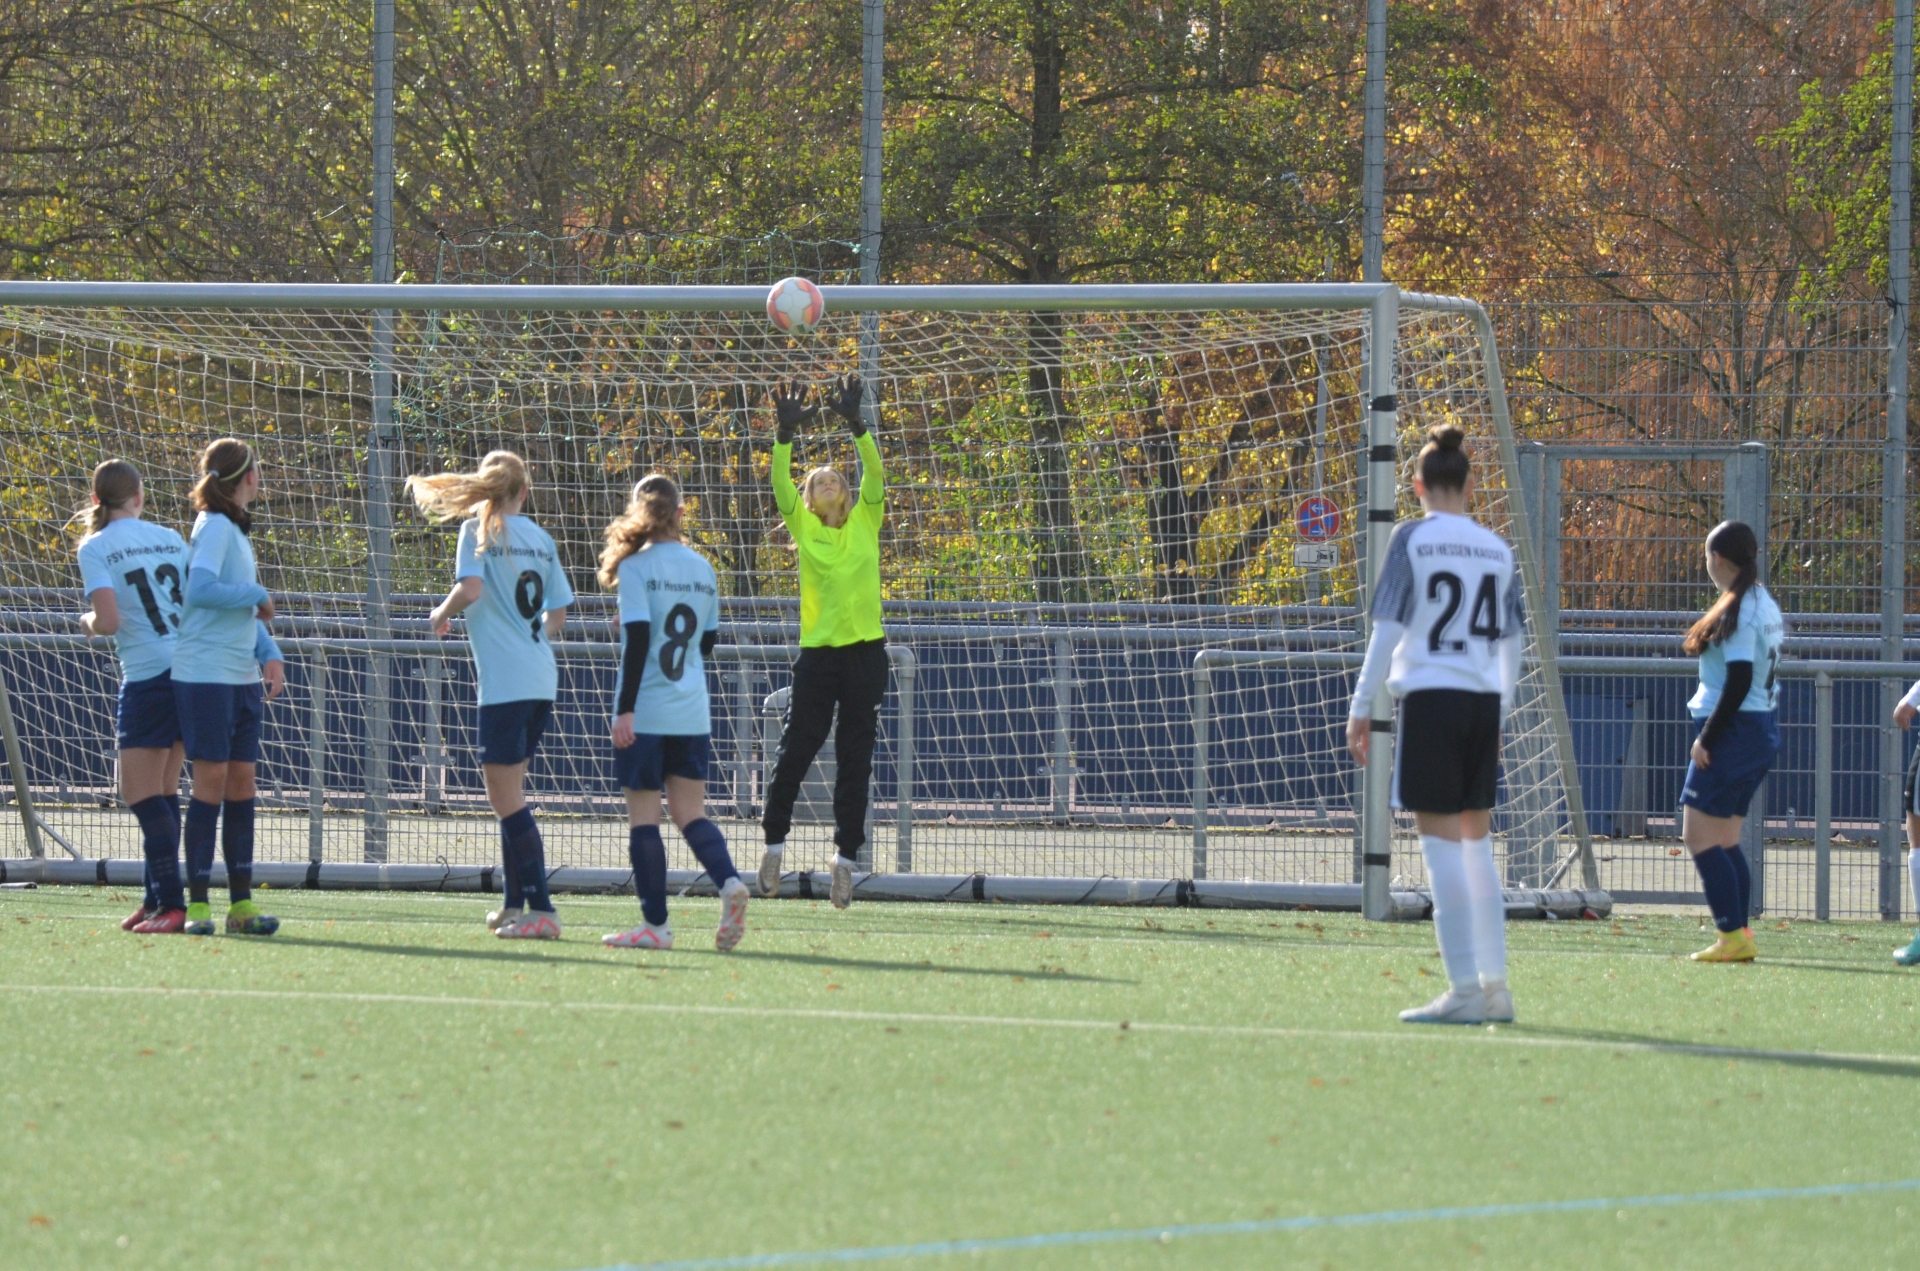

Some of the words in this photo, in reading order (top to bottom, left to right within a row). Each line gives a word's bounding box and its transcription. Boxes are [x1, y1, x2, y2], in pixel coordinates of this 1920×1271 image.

[106, 551, 124, 565] FSV
[506, 546, 535, 558] Hessen
[1415, 544, 1433, 558] KSV
[1436, 543, 1471, 558] HESSEN
[1473, 547, 1505, 563] KASSEL
[663, 581, 691, 593] Hessen
[124, 563, 183, 636] 13
[1427, 571, 1500, 657] 24
[658, 603, 697, 682] 8
